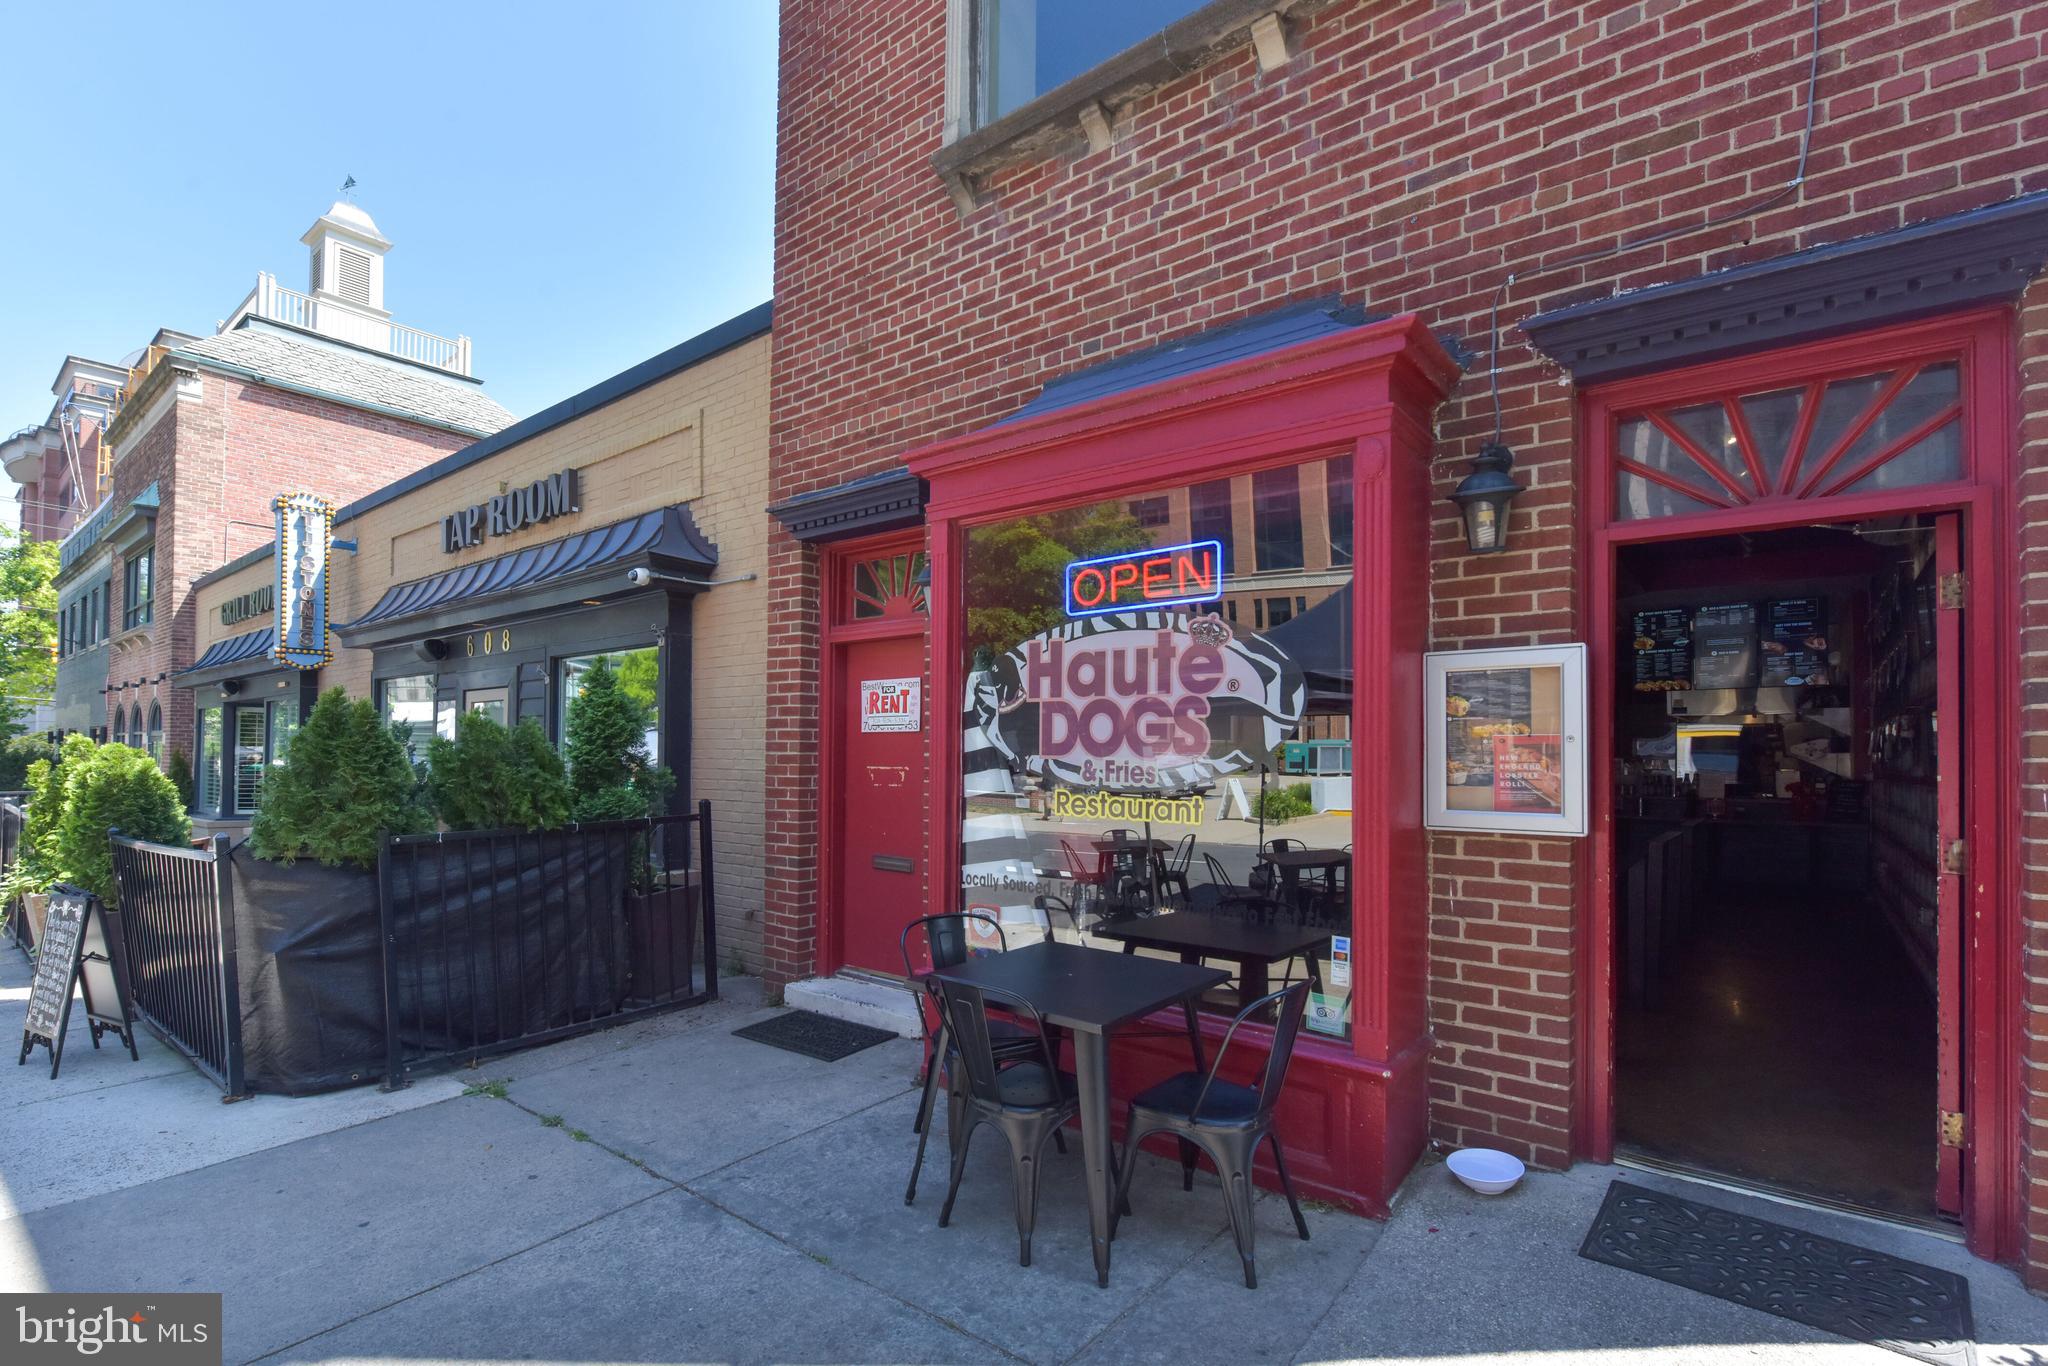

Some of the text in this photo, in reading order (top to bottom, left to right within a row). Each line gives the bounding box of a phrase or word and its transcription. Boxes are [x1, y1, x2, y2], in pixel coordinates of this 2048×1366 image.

[440, 468, 579, 553] TAP ROOM
[1073, 551, 1211, 606] OPEN
[222, 584, 275, 625] GRILL ROO
[467, 629, 510, 657] 608
[1027, 629, 1225, 700] Haute
[869, 689, 909, 714] RENT
[1040, 696, 1211, 759] DOGS
[1081, 759, 1158, 785] & Fries
[1055, 790, 1204, 824] Restaurant
